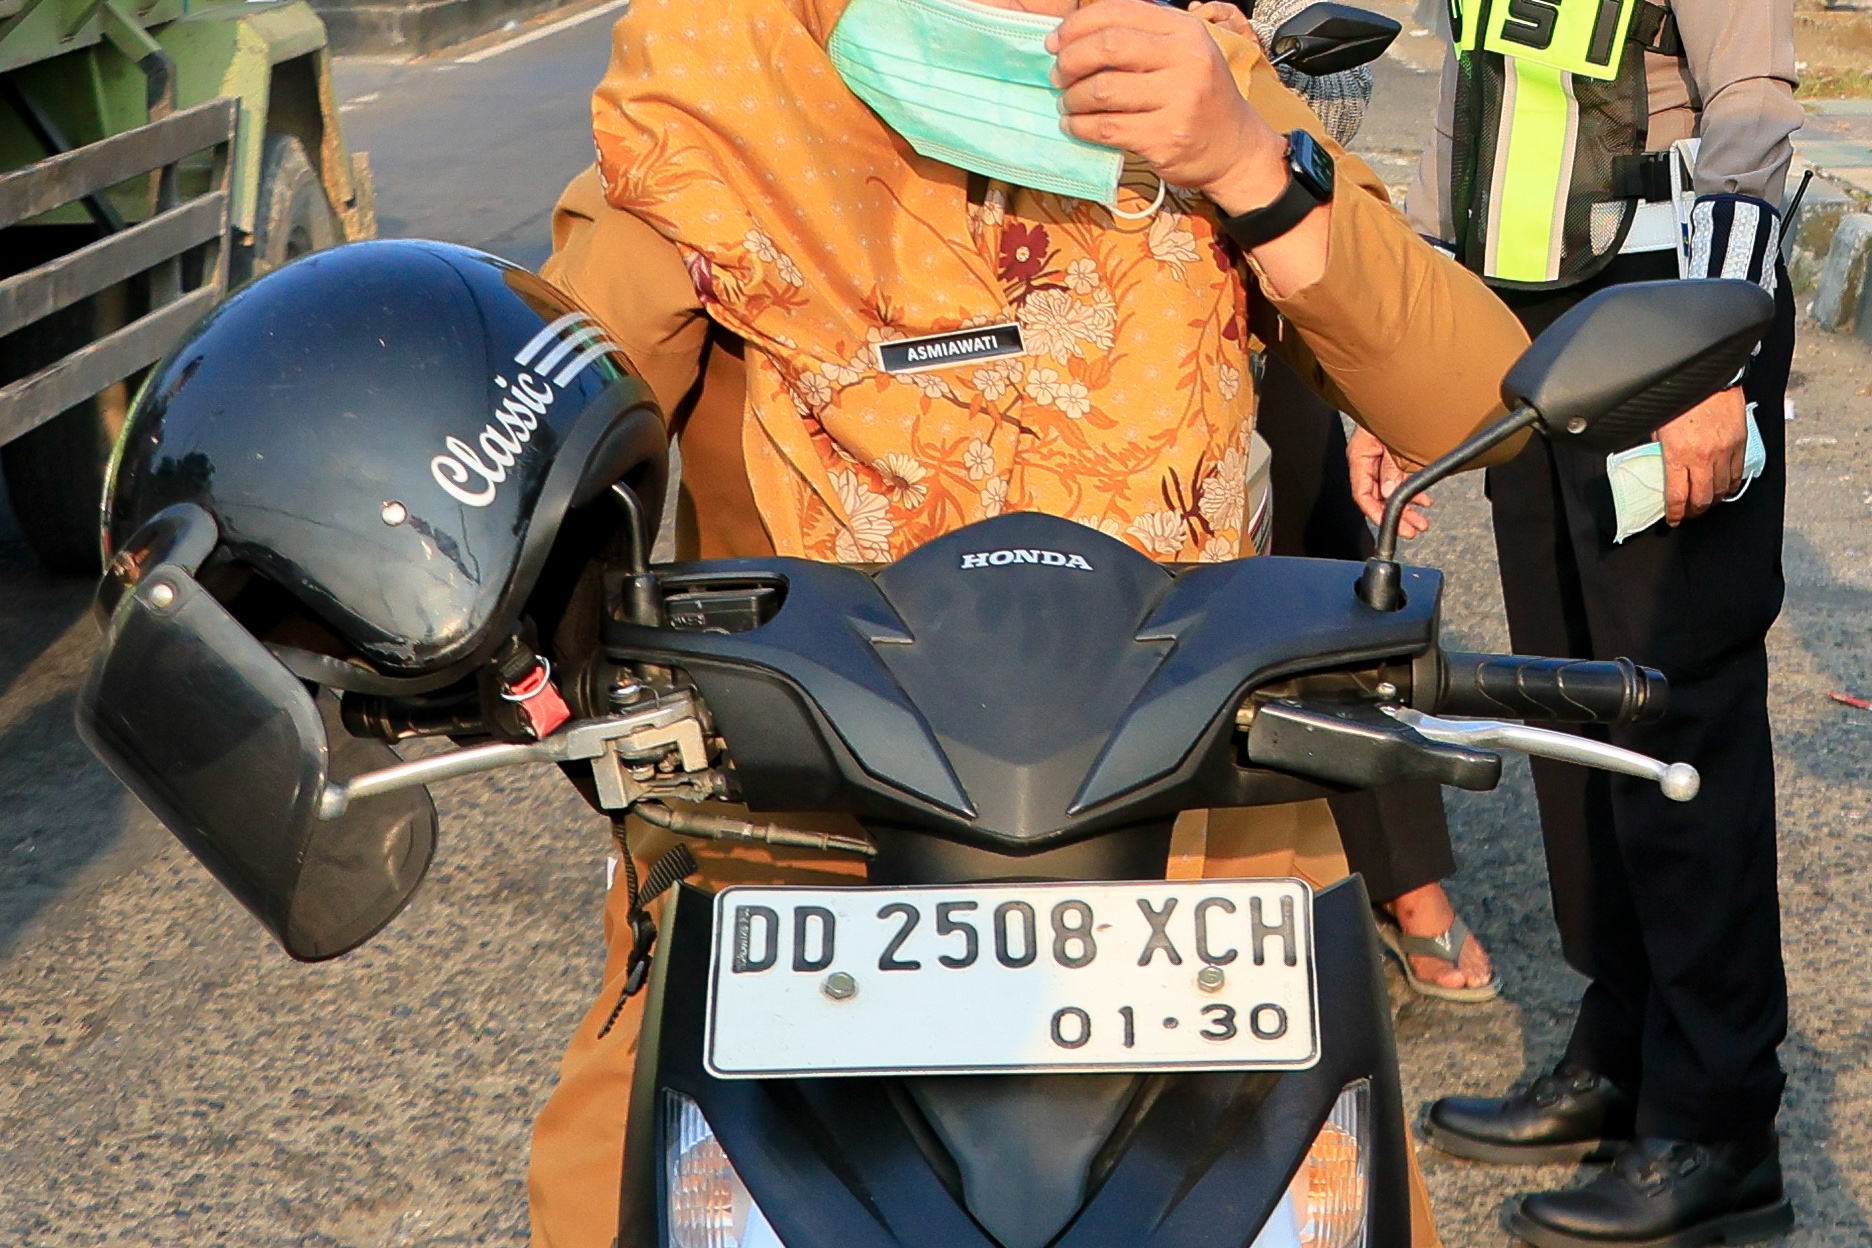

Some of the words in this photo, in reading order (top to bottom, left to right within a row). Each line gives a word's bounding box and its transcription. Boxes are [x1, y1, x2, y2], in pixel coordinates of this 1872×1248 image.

[907, 335, 998, 362] ASMIAWATI
[431, 372, 554, 507] Classic
[960, 549, 1094, 571] HONDA
[732, 904, 836, 974] DD
[876, 900, 1097, 971] 2508
[1136, 894, 1298, 968] XCH
